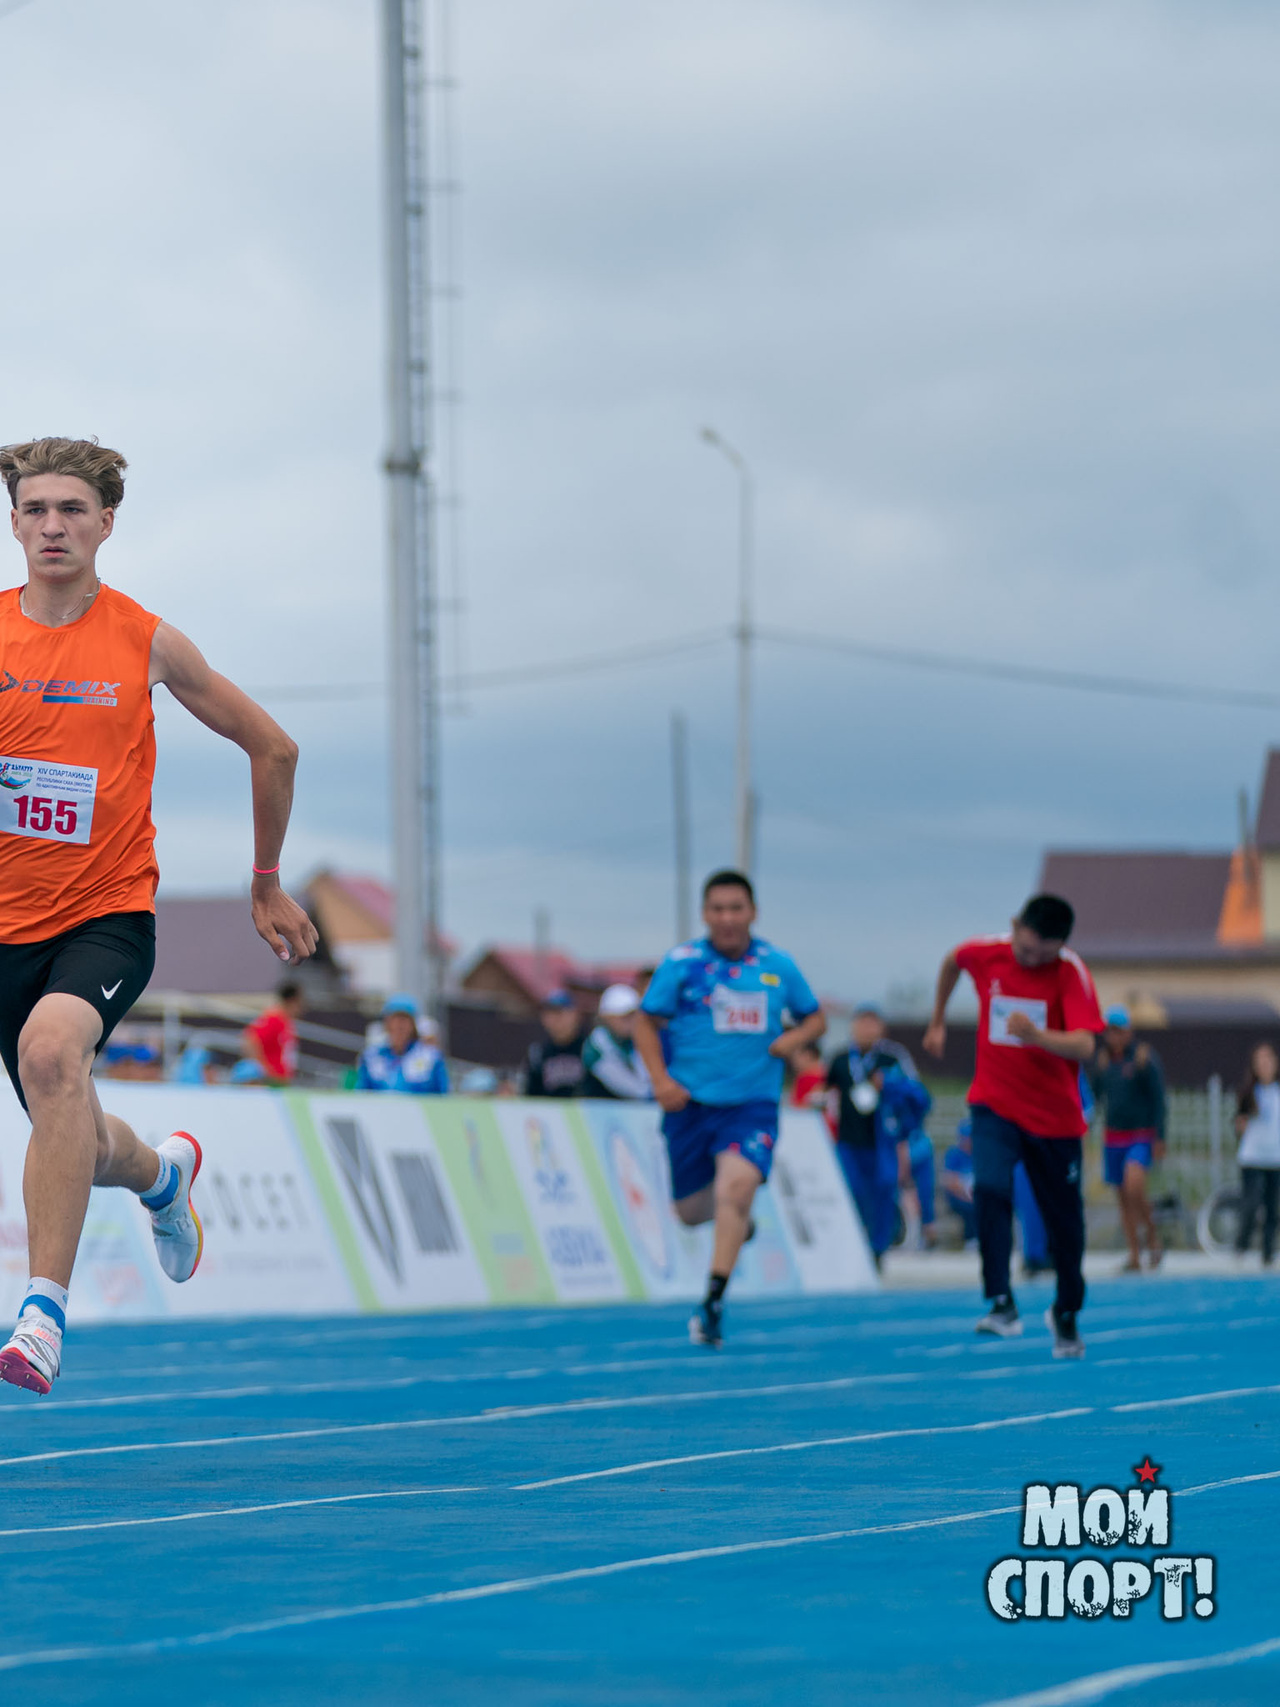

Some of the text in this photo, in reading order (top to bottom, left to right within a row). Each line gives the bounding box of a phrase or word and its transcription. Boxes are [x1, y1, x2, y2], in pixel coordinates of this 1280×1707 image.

[21, 679, 121, 696] DEMIX
[83, 696, 115, 706] TRAINING
[37, 767, 48, 775] XIV
[48, 769, 94, 781] СПАРТАКИАДА
[13, 795, 78, 836] 155
[33, 1328, 59, 1349] NIKE
